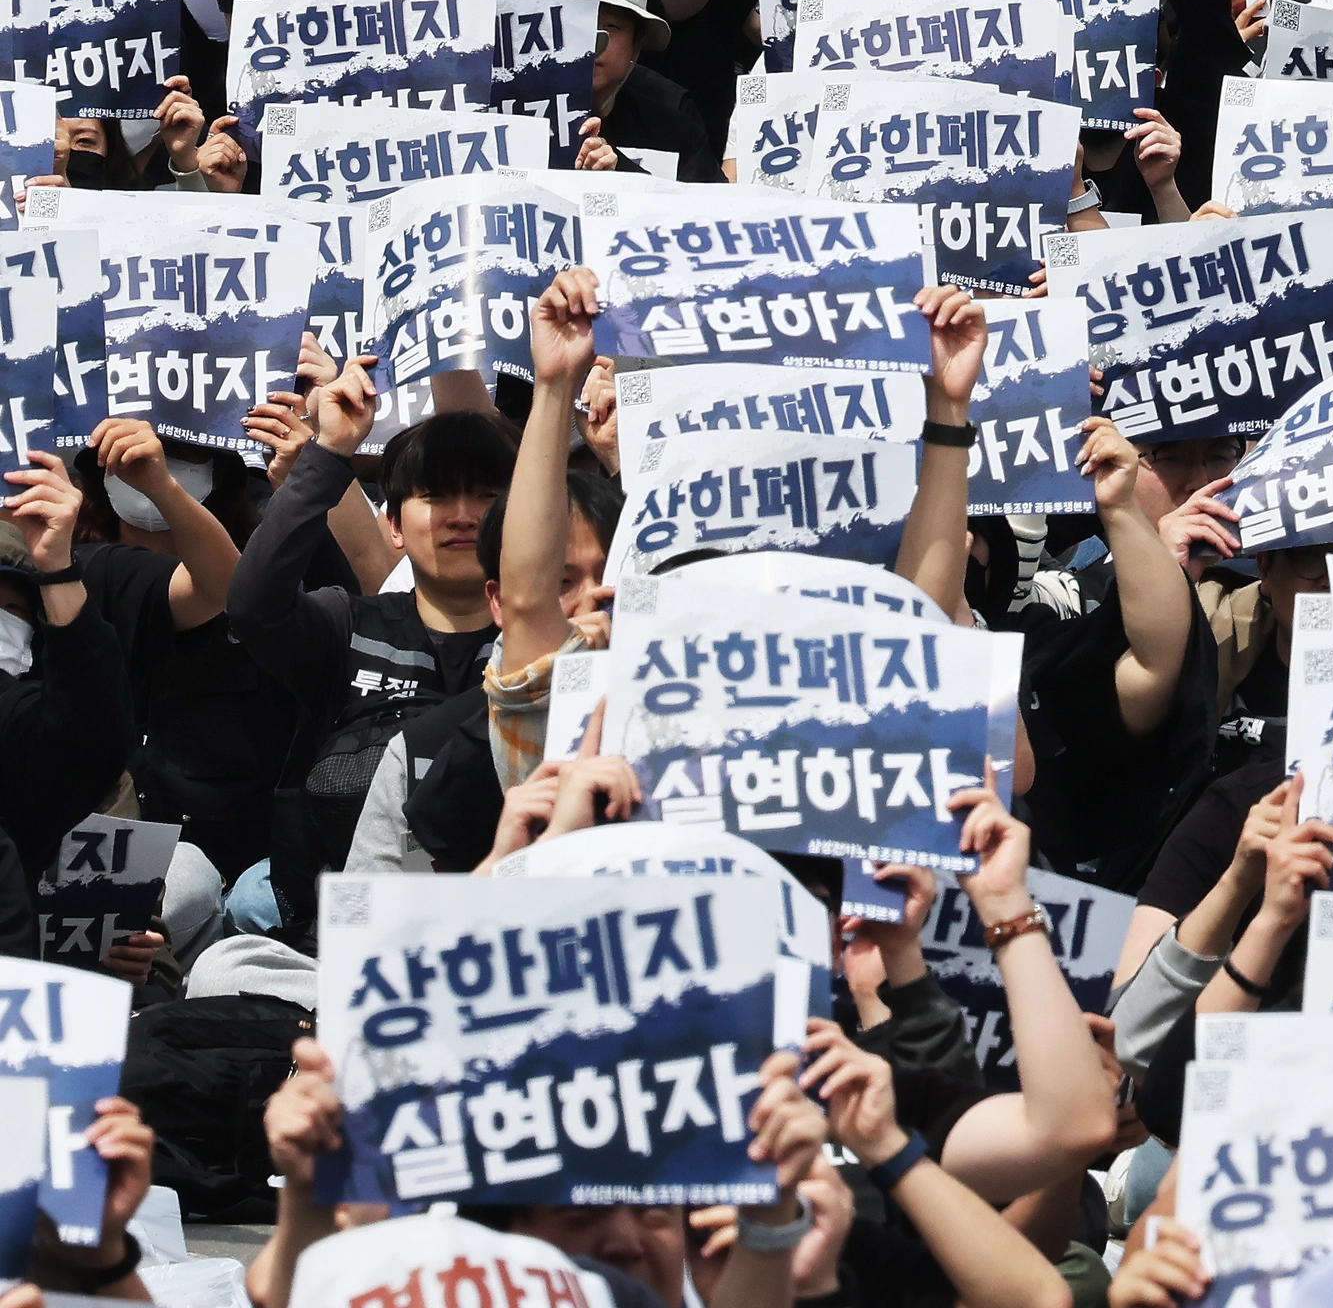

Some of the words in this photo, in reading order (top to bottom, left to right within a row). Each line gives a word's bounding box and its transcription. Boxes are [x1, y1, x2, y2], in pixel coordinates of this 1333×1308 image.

[78, 108, 134, 118] 삼성전자노동조합
[827, 106, 1042, 181] 상한폐지
[376, 195, 584, 287] 상한폐지
[608, 212, 875, 277] 상한폐지
[641, 287, 909, 354] 실현하자
[941, 272, 1004, 293] 삼성전자노동조합
[1076, 223, 1308, 344] 상한폐지
[157, 423, 225, 447] 삼성전자노동조합
[634, 451, 878, 553] 상한폐지
[1034, 501, 1092, 514] 공동투쟁본부
[633, 633, 941, 714] 상한폐지
[652, 747, 966, 828] 실현하자
[351, 892, 716, 1050] 상한폐지
[378, 1042, 764, 1197] 실현하자
